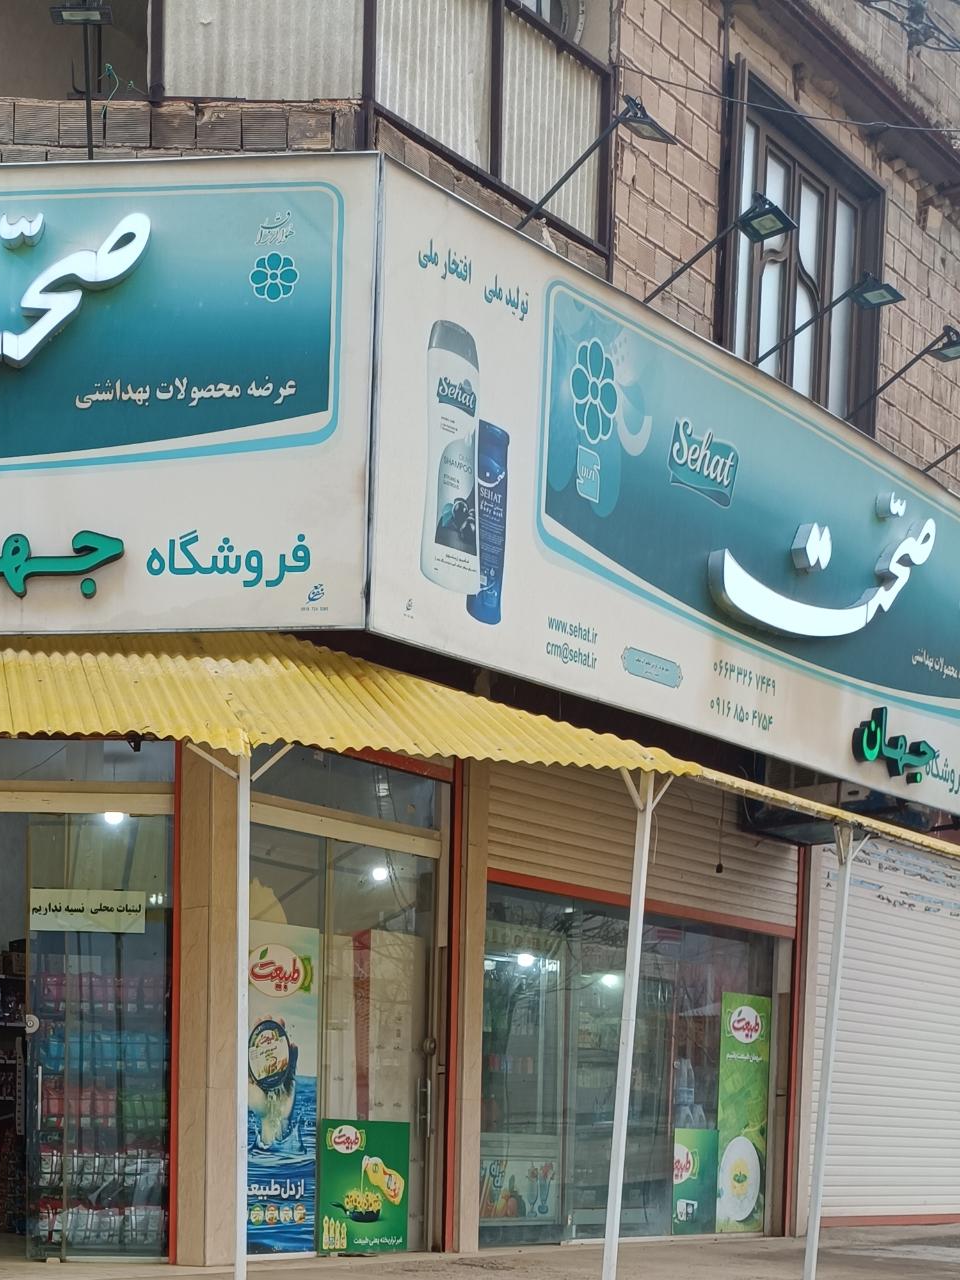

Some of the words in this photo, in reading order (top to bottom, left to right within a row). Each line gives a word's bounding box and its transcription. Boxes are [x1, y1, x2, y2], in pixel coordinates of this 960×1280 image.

[418, 238, 438, 269] ملی
[441, 248, 471, 284] افتخار
[484, 274, 503, 303] ملی
[505, 285, 529, 321] تولید
[75, 378, 151, 409] بهداشتی
[155, 376, 241, 407] محصولات
[246, 375, 297, 405] عرضه
[438, 376, 475, 409] Sehat
[672, 419, 734, 487] Sehat
[480, 486, 502, 503] SEHAT
[146, 529, 311, 588] فروشگاه
[547, 615, 598, 644] www.sehat.ir
[546, 641, 597, 670] crm@sehat.ir
[855, 706, 936, 784] جهان
[925, 749, 960, 795] روشگاه
[32, 902, 62, 915] نداریم
[64, 903, 85, 915] نسیه
[90, 903, 114, 914] محلی
[116, 904, 141, 916] لبنیات
[250, 958, 300, 992] طبیعت
[732, 1014, 759, 1039] طبیعت
[333, 1131, 359, 1150] طبیعت
[247, 1178, 281, 1200] طبیع
[281, 1178, 296, 1199] دل
[296, 1178, 304, 1199] از
